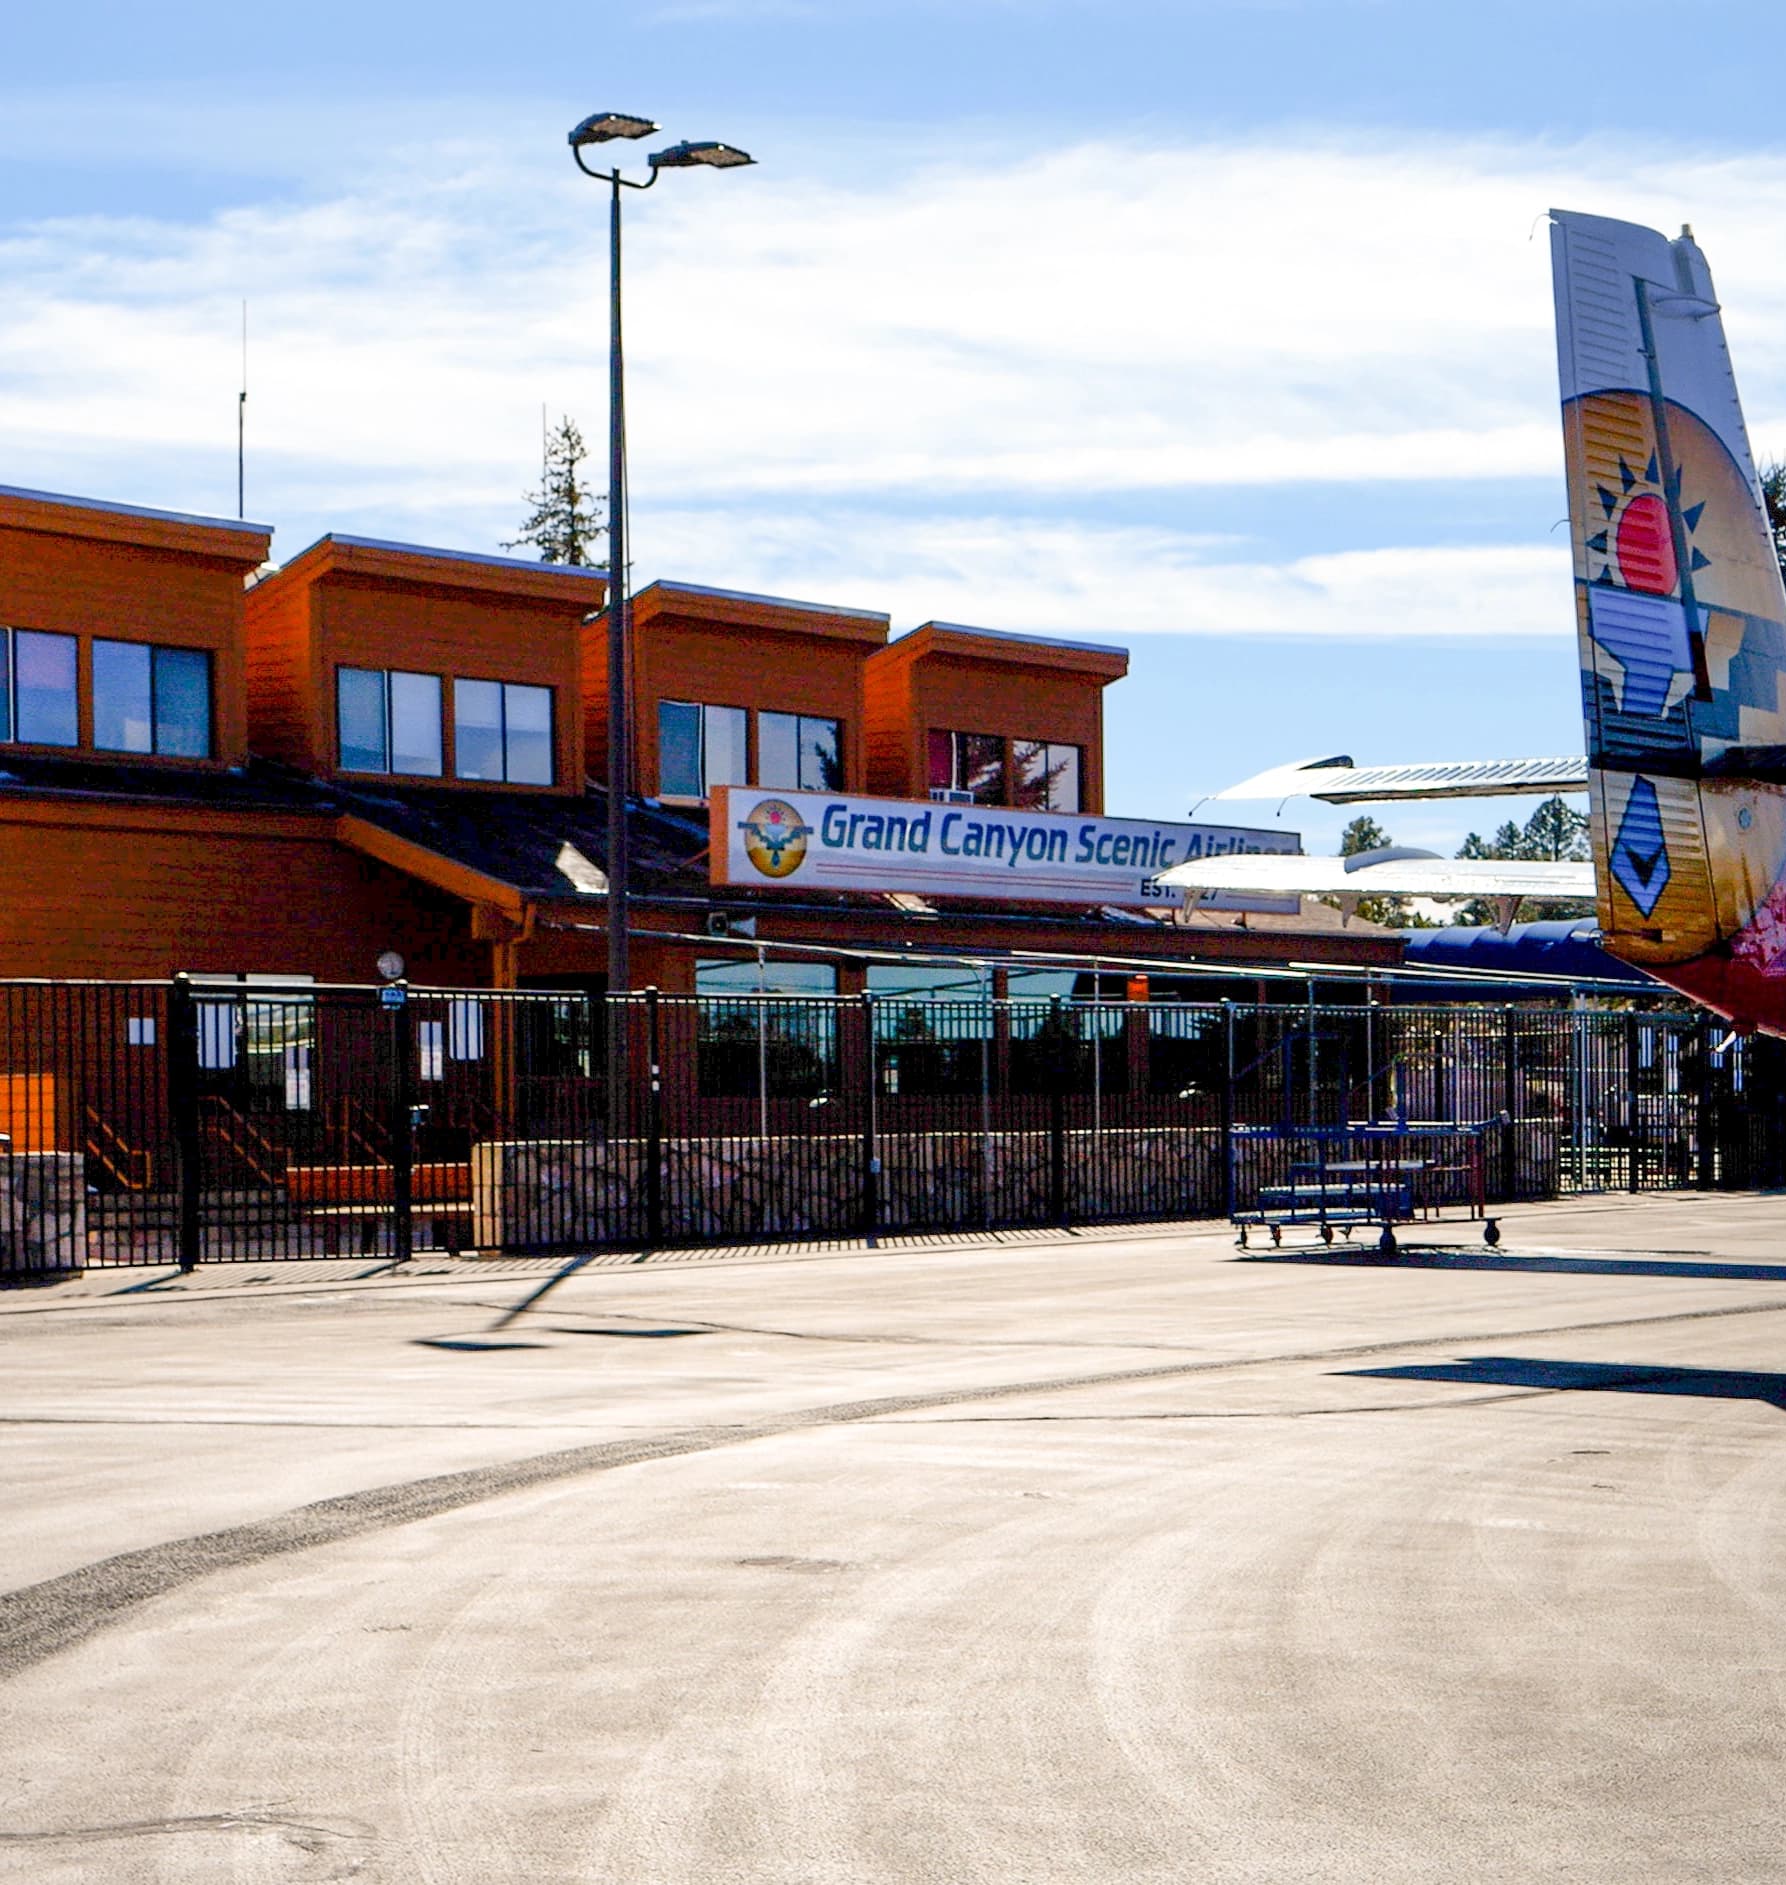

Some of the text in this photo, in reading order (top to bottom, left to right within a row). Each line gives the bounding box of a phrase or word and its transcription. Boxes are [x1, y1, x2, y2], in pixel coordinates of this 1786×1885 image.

[821, 804, 932, 853] Grand
[940, 812, 1068, 868] Canyon
[1075, 825, 1176, 868] Scenic
